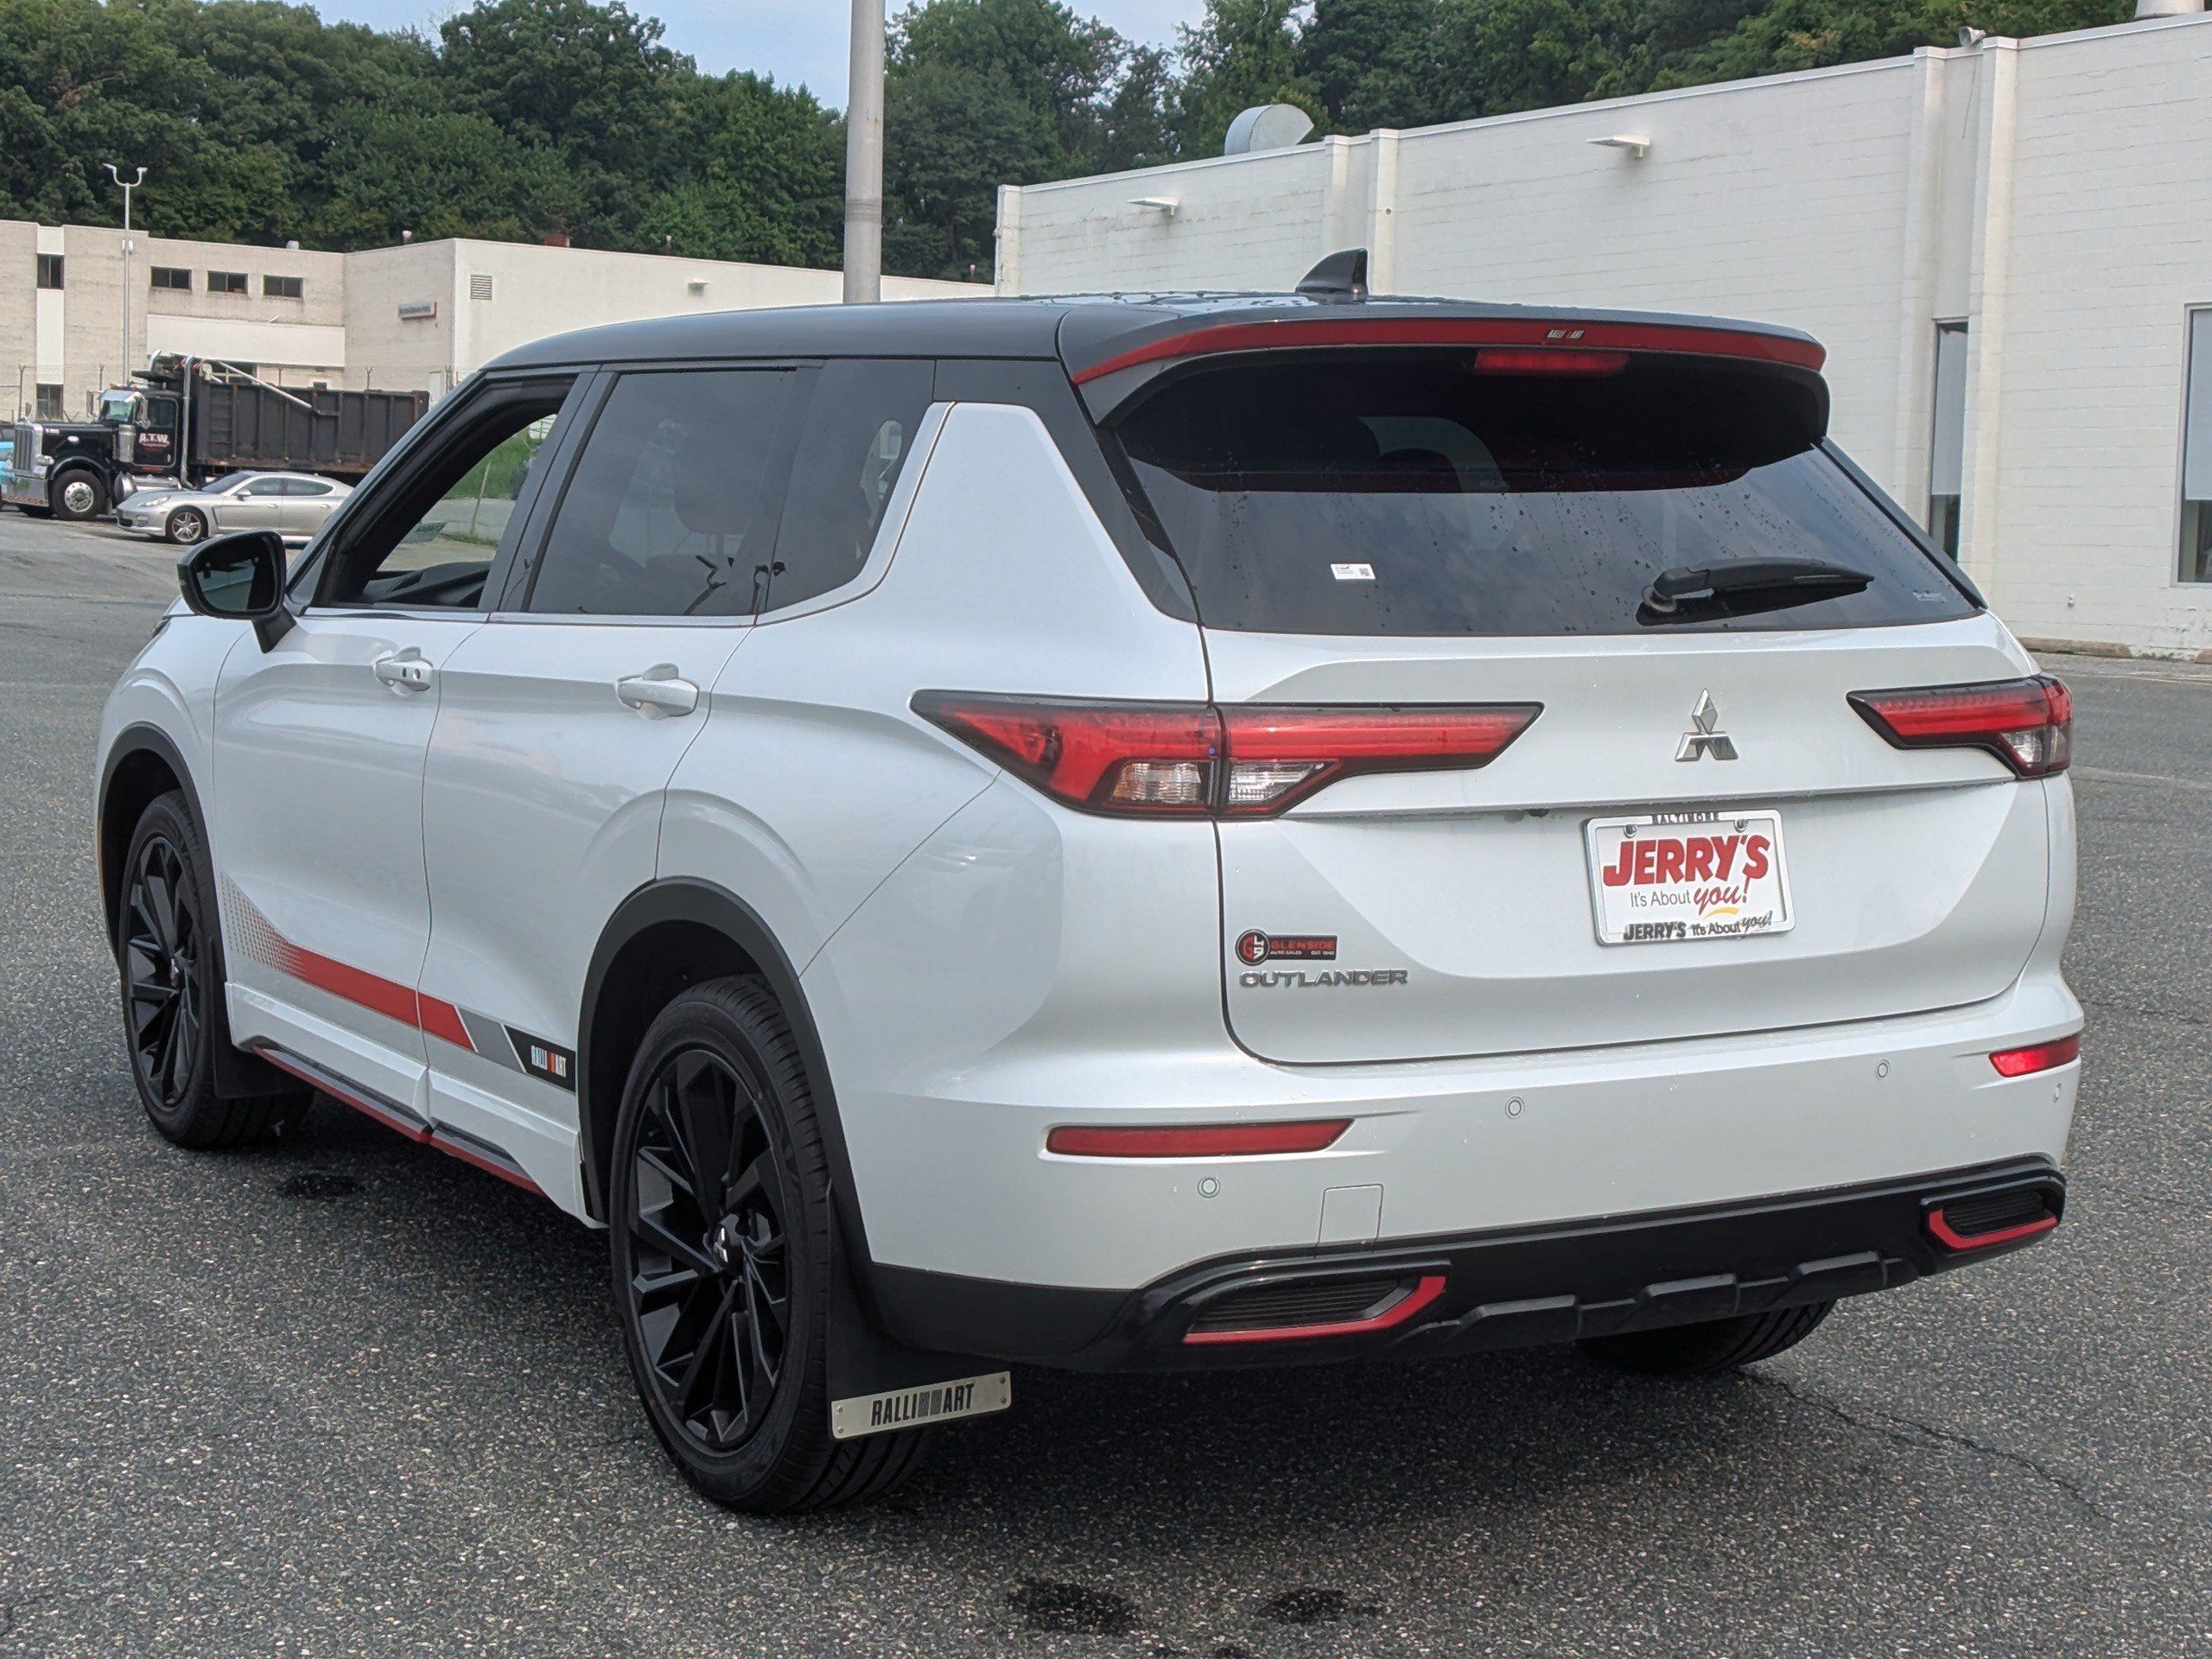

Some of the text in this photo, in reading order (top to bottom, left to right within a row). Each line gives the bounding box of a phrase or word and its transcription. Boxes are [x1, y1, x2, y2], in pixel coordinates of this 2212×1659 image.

[1603, 835, 1771, 887] JERRY'S
[1630, 875, 1750, 916] It's About you!
[1623, 921, 1687, 941] JERRY'S
[1708, 921, 1741, 935] About
[1741, 910, 1773, 932] you!
[1239, 969, 1408, 988] OUTLANDER
